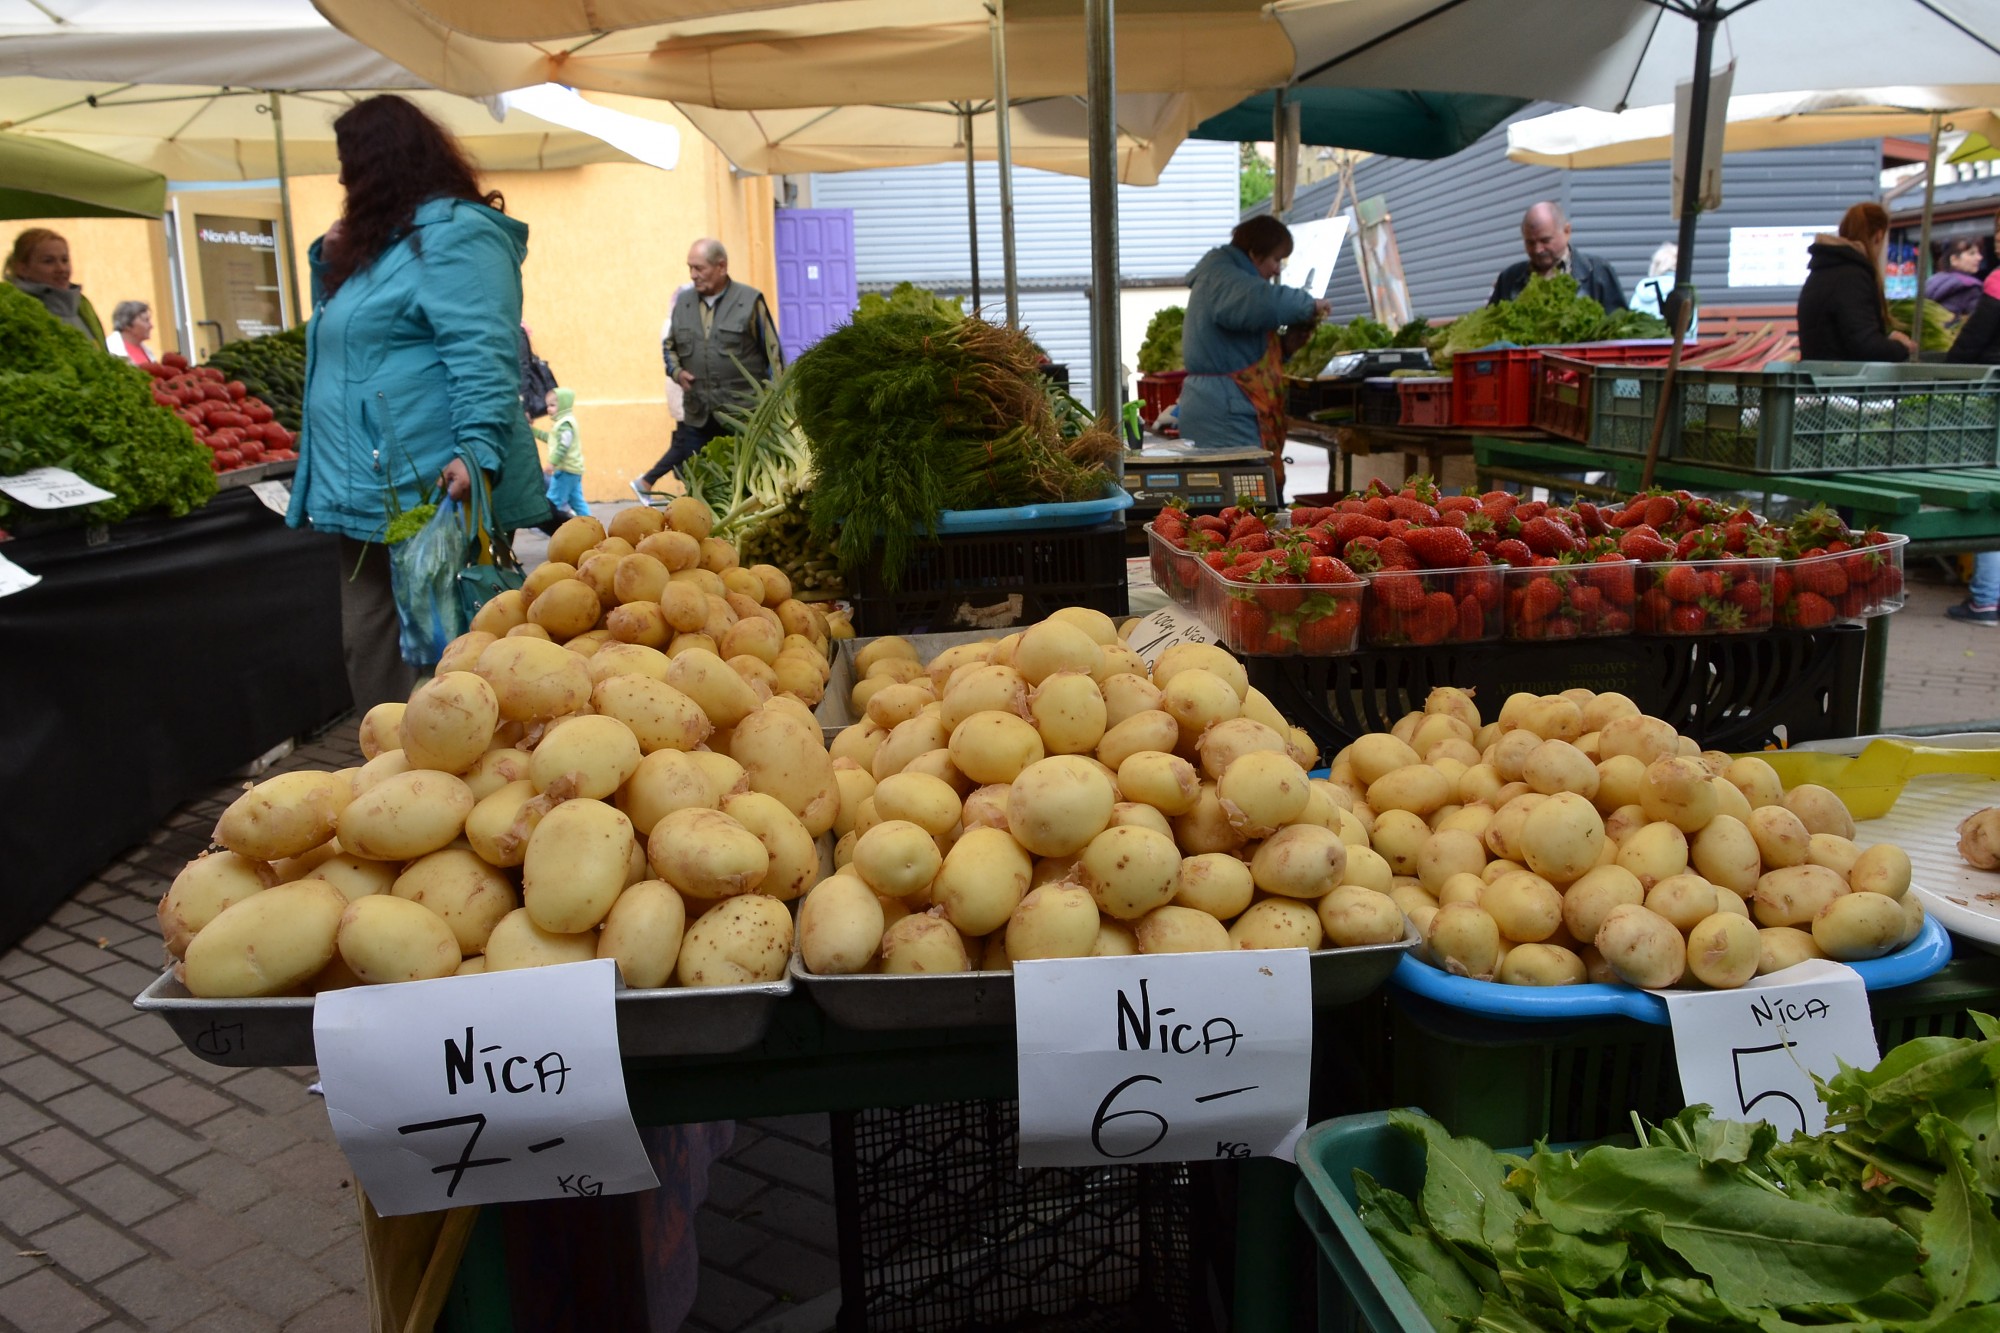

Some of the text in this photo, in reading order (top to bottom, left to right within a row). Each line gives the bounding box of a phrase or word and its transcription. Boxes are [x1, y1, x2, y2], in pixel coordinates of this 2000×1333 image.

[203, 229, 274, 246] Norvik Banka
[1568, 661, 1628, 676] SAPORE
